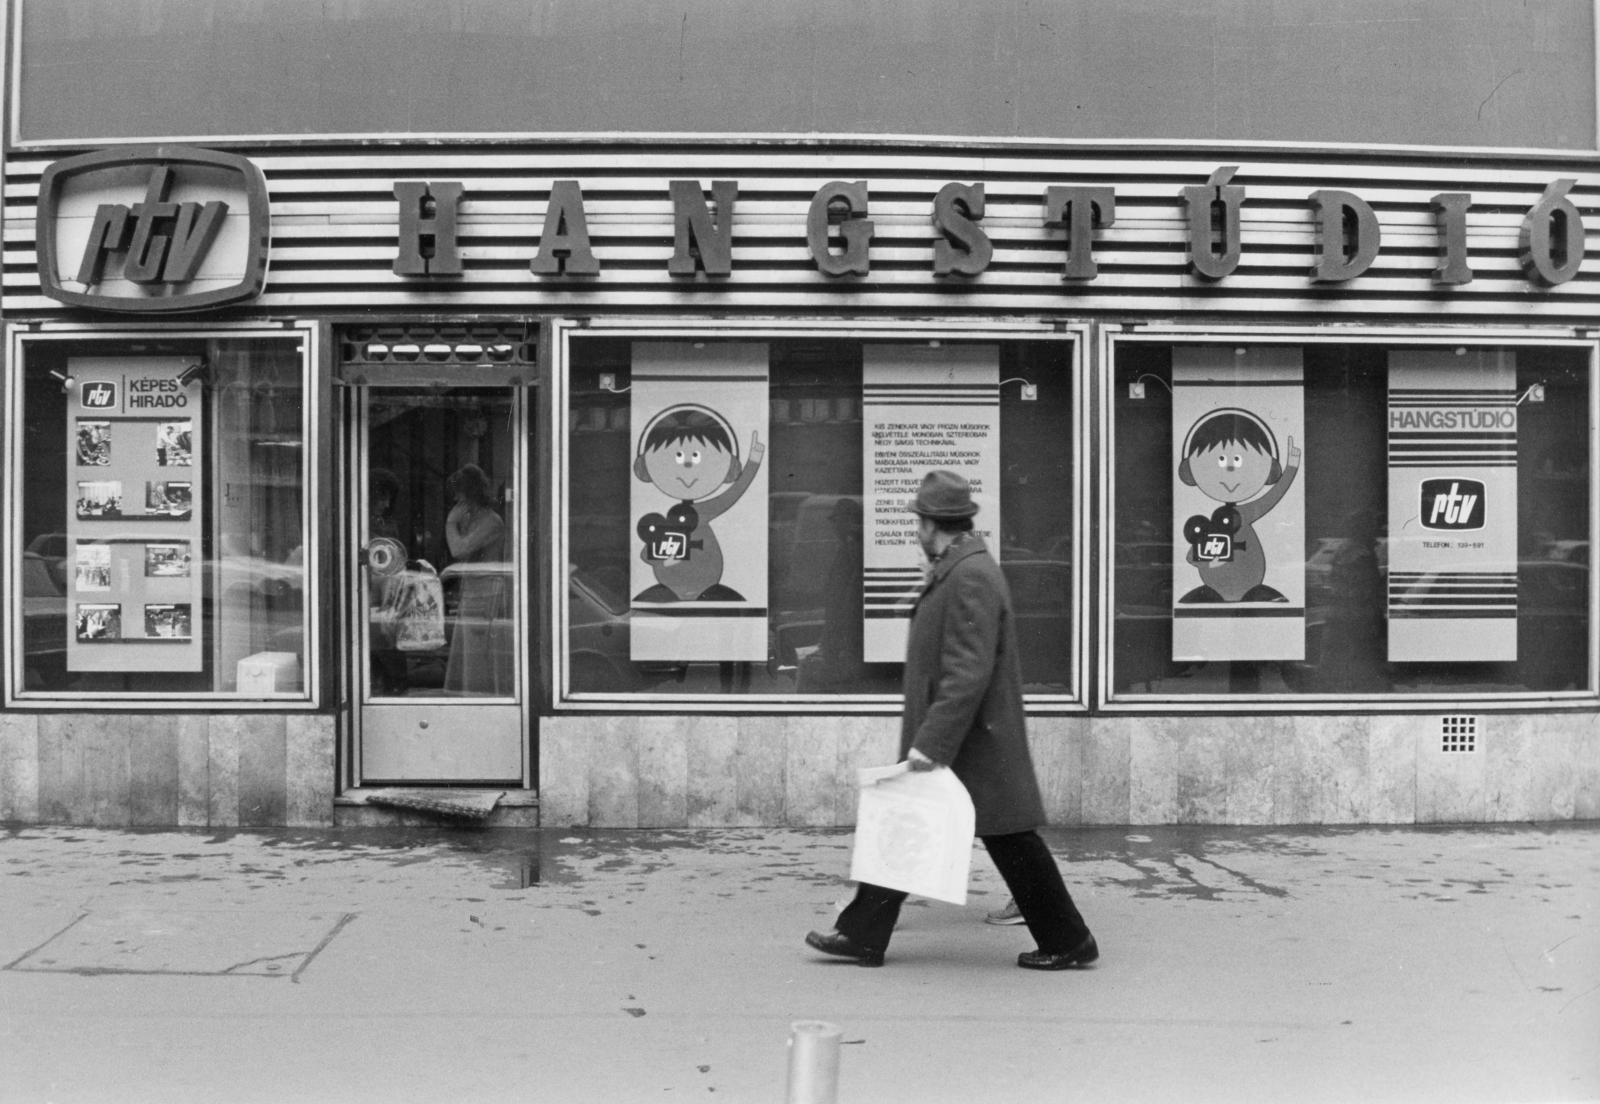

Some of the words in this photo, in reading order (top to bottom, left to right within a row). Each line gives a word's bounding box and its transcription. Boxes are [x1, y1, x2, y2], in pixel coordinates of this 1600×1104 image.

[393, 165, 1586, 287] HANGSTÚDIÓ
[130, 376, 178, 392] KÉPES
[1390, 408, 1515, 429] HANGSTÚDIÓ
[964, 458, 980, 466] VAGY
[1429, 482, 1478, 524] rtv
